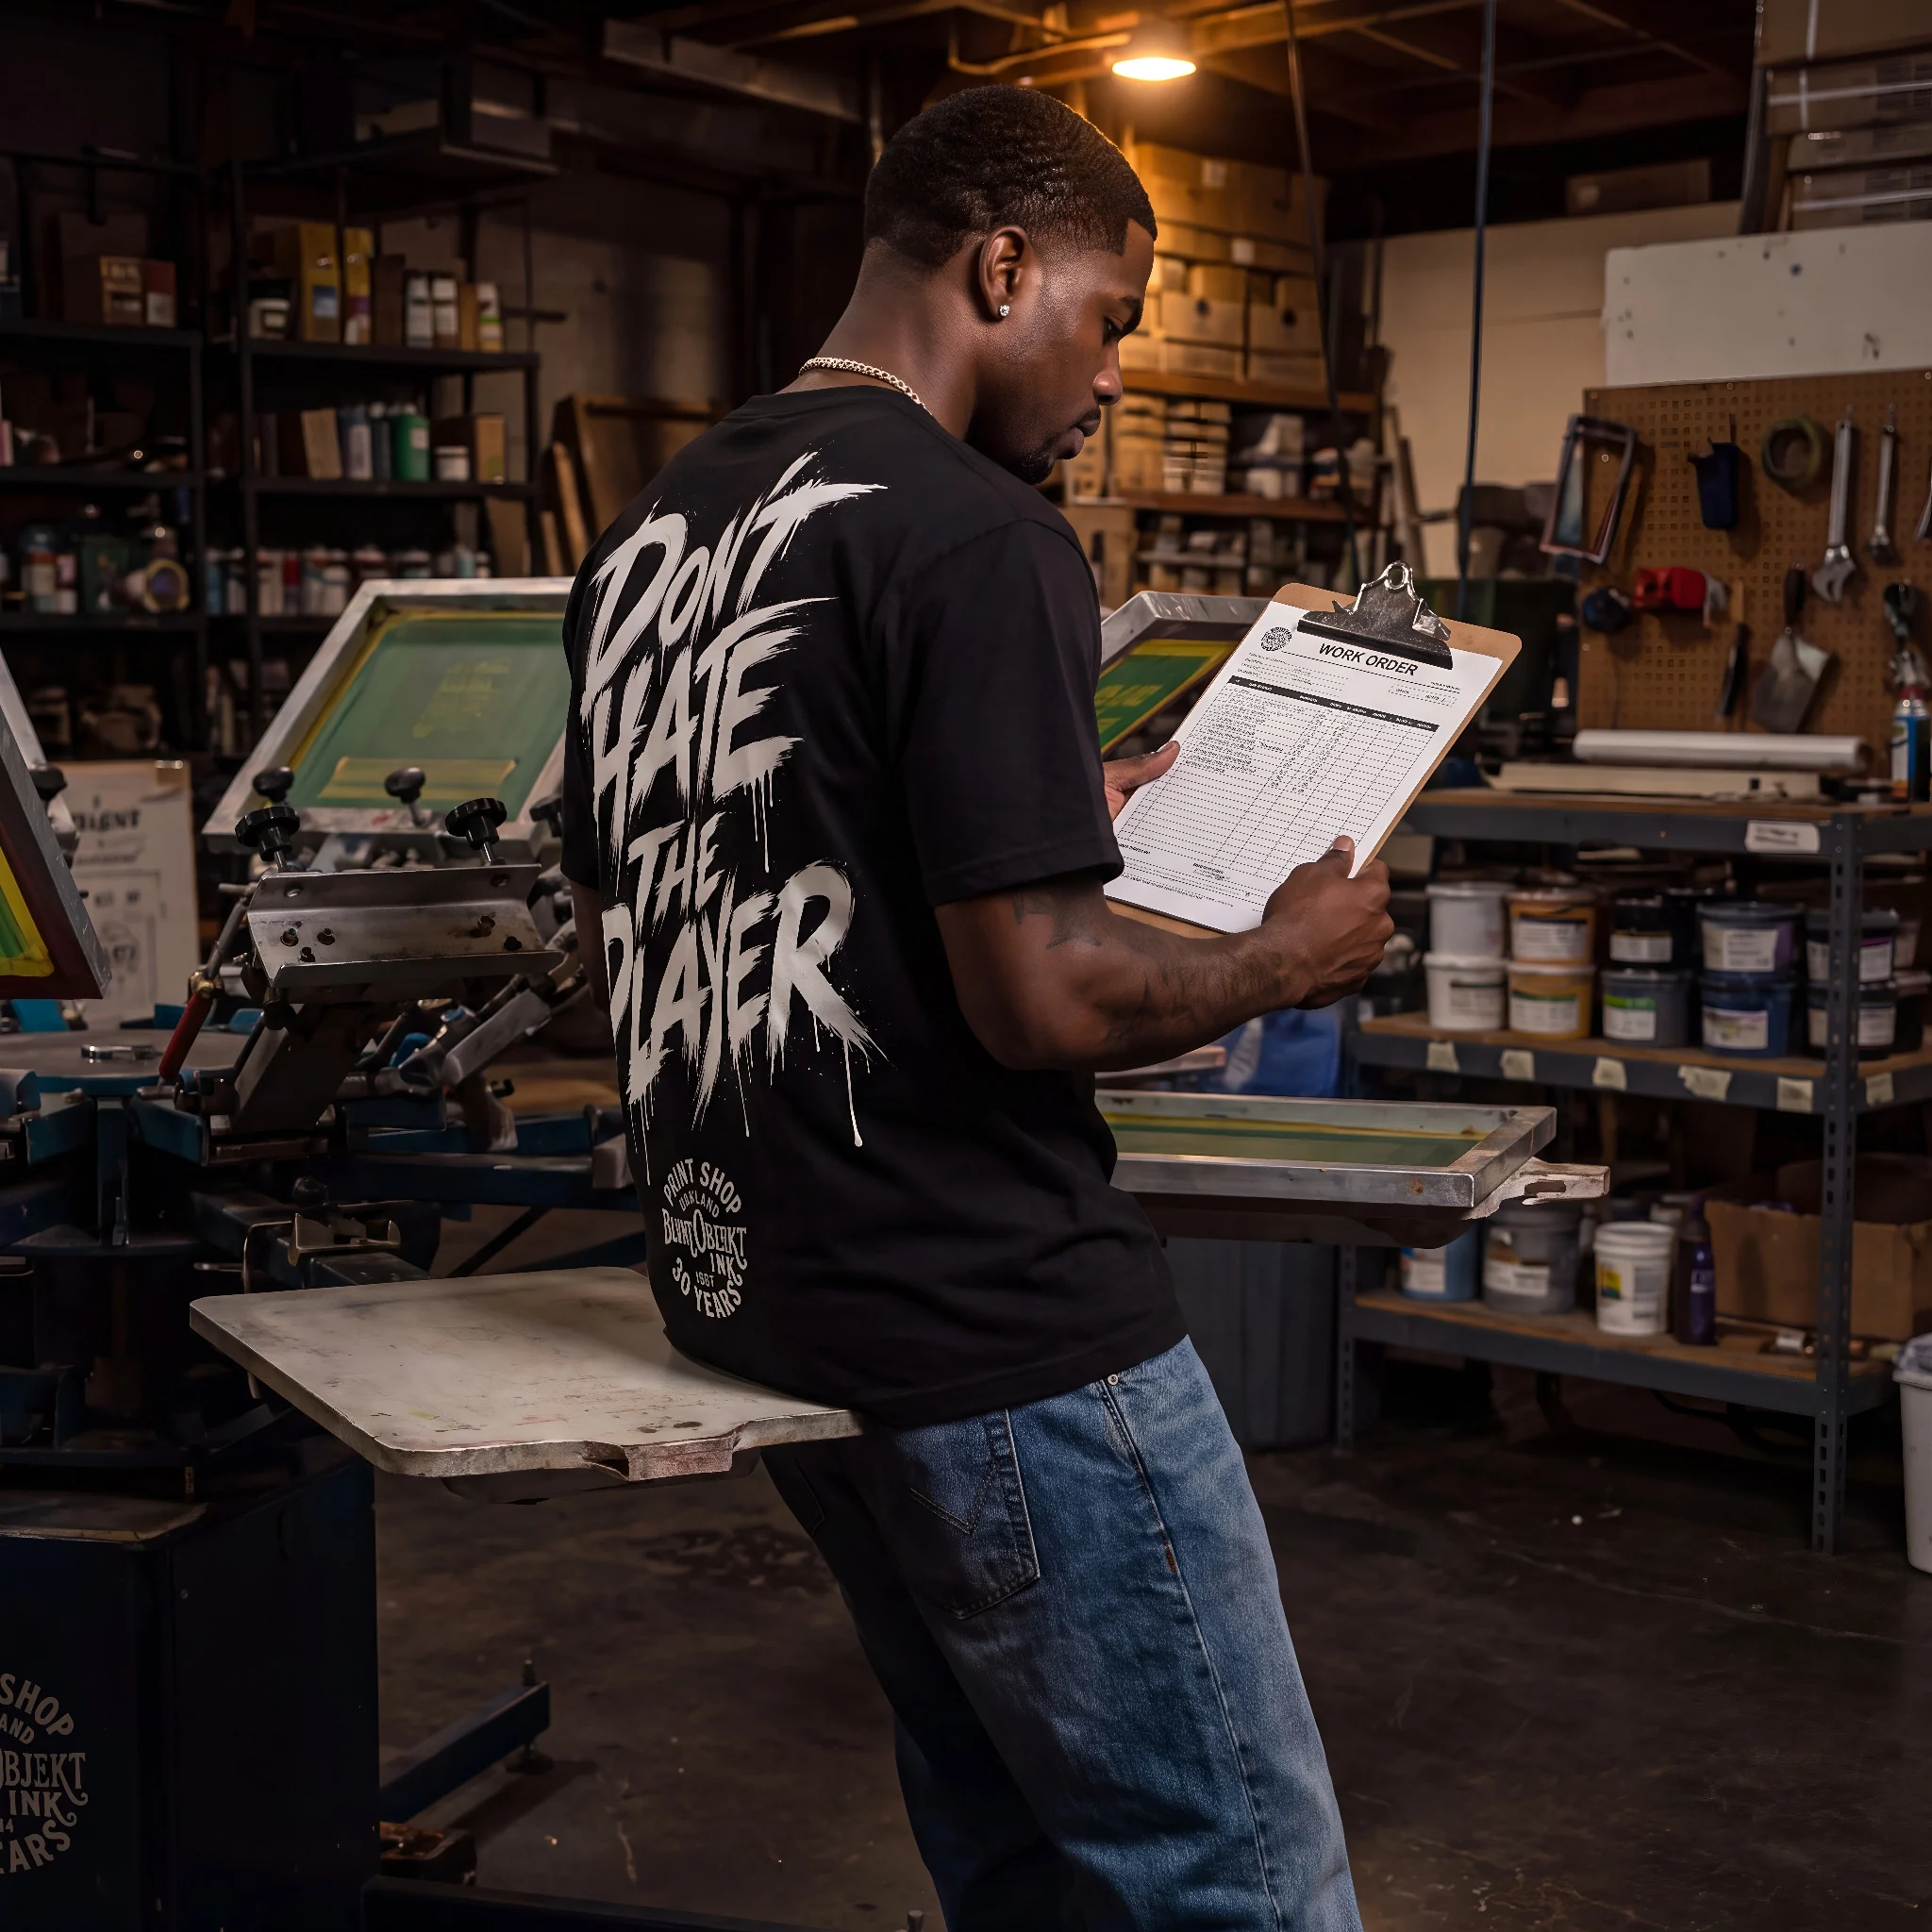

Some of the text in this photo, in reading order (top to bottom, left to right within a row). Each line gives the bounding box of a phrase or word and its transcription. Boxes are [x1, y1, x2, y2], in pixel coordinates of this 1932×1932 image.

[1319, 642, 1419, 676] WORK ORDER
[591, 597, 839, 828] HATE
[626, 811, 726, 941] THE
[602, 858, 889, 1113] PLAYER
[663, 1158, 742, 1213] PRINT SHOP
[672, 1257, 741, 1318] 30 YEARS
[709, 1252, 743, 1287] INK
[0, 1673, 75, 1736] SHOP
[0, 1747, 89, 1807] BJEKT
[8, 1790, 77, 1827] INK
[0, 1819, 71, 1874] ARS
